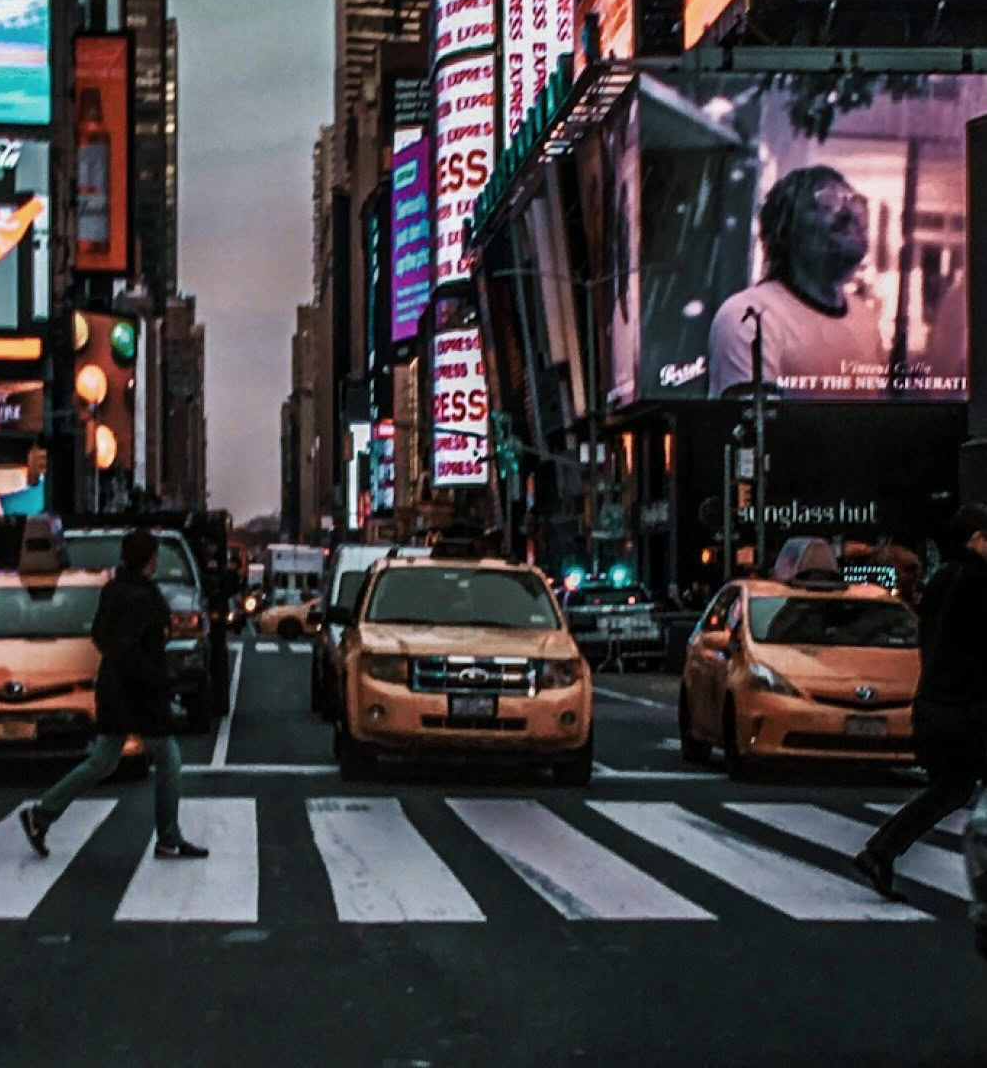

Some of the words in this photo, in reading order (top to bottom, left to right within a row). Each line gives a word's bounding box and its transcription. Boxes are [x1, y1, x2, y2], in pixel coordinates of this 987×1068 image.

[659, 355, 706, 386] Persol
[777, 376, 815, 389] MEET
[821, 376, 851, 390] THE
[856, 377, 889, 390] NEW
[839, 498, 879, 524] hut
